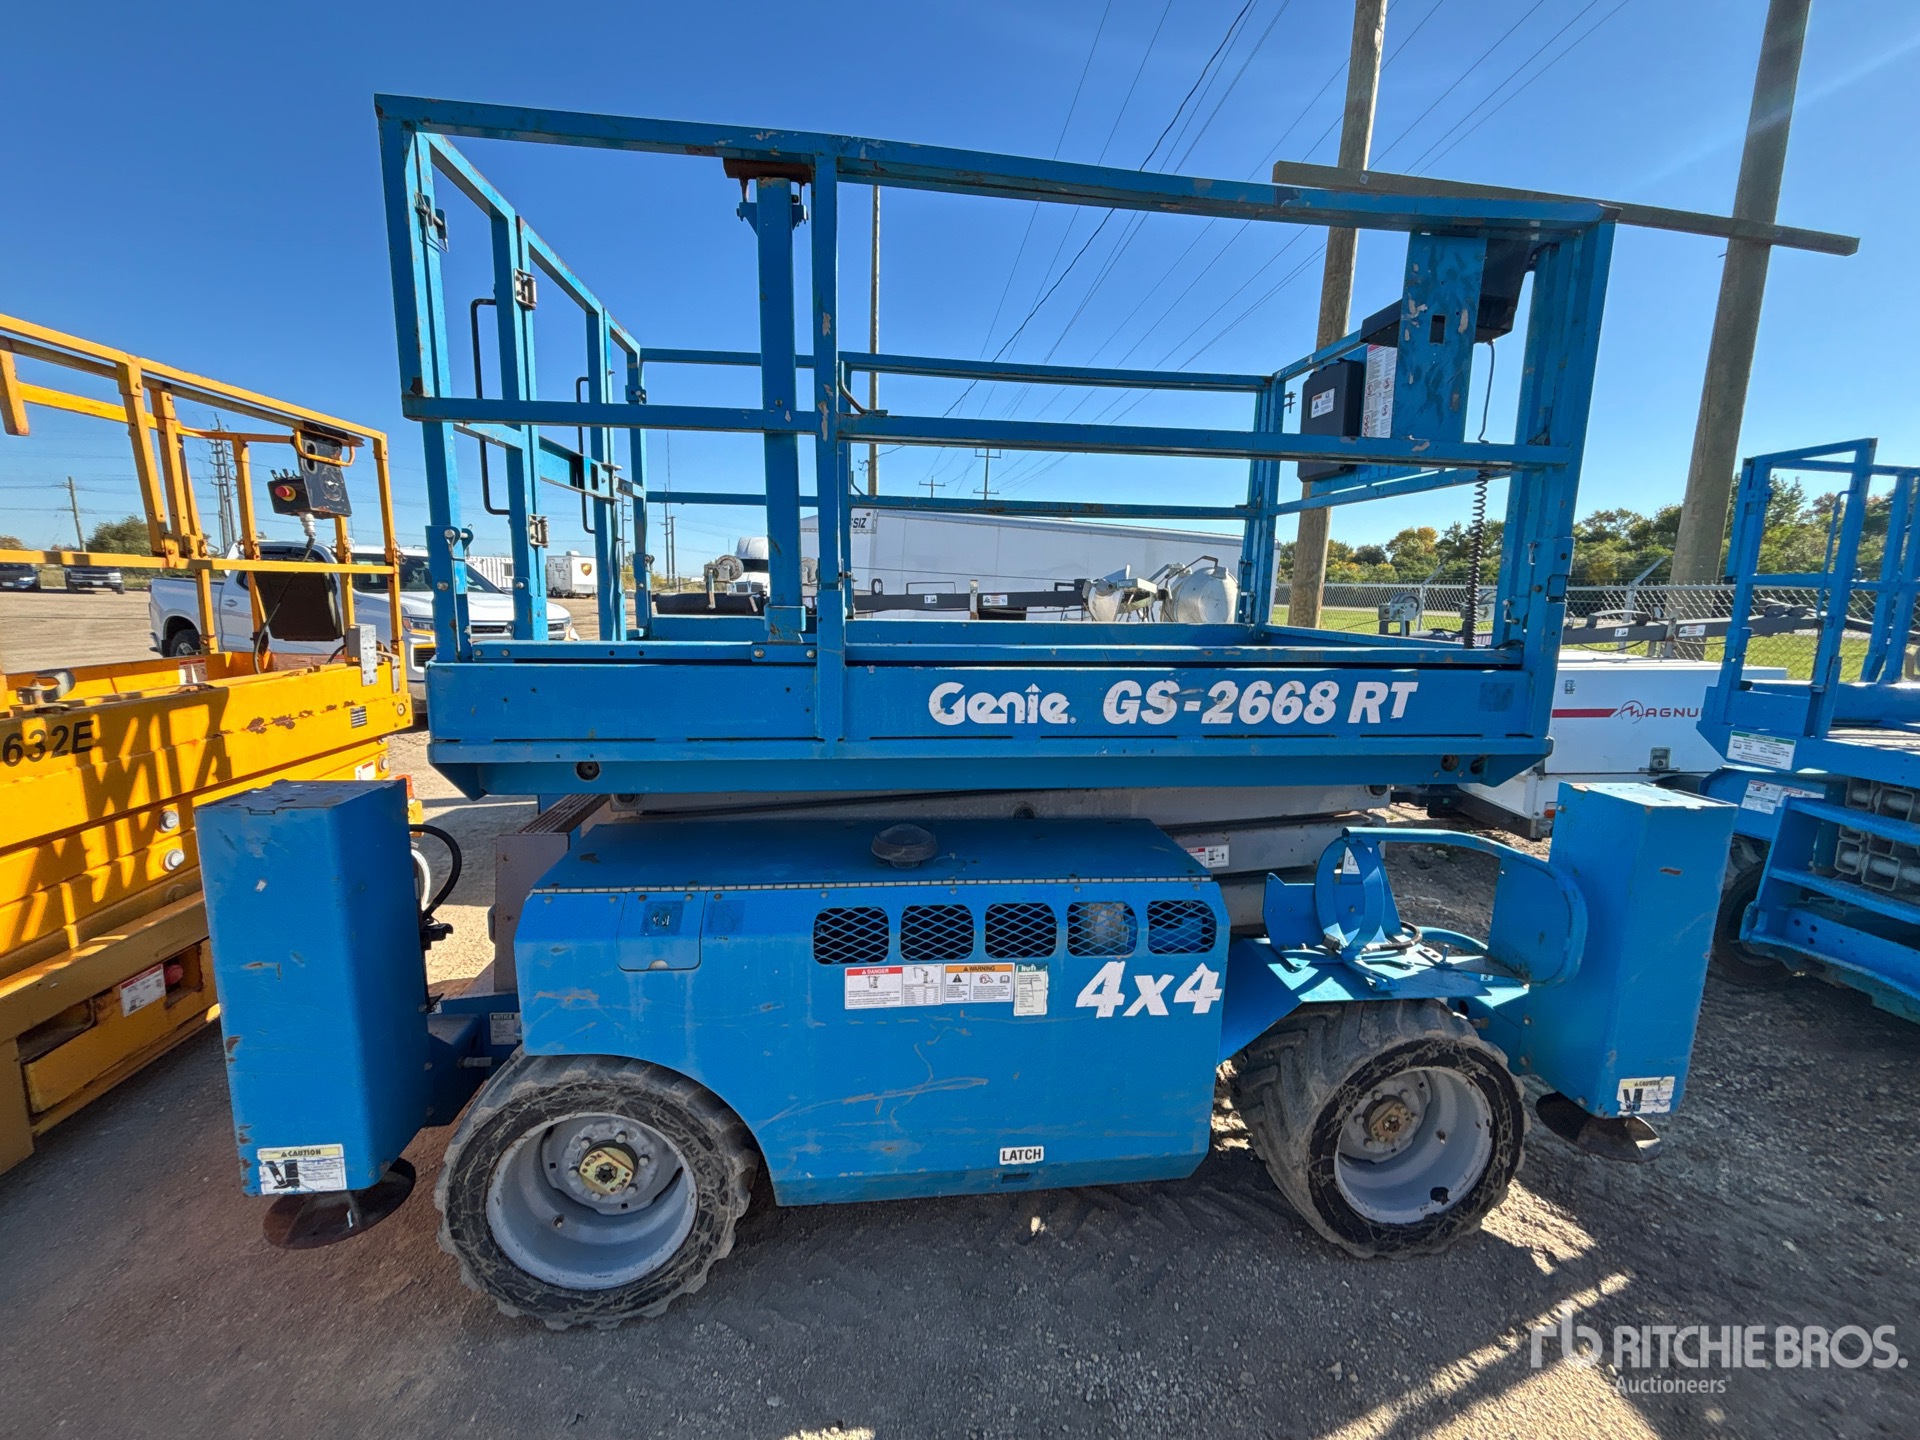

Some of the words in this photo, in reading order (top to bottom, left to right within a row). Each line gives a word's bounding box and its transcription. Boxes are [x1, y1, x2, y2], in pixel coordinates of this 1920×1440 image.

[928, 682, 1071, 726] Genie
[1102, 680, 1340, 725] GS-2668
[1347, 681, 1419, 724] RT
[1614, 701, 1699, 722] MAGNU
[1075, 961, 1223, 1018] 4x4
[287, 1149, 322, 1157] CAUTION
[1002, 1148, 1041, 1161] LATCH
